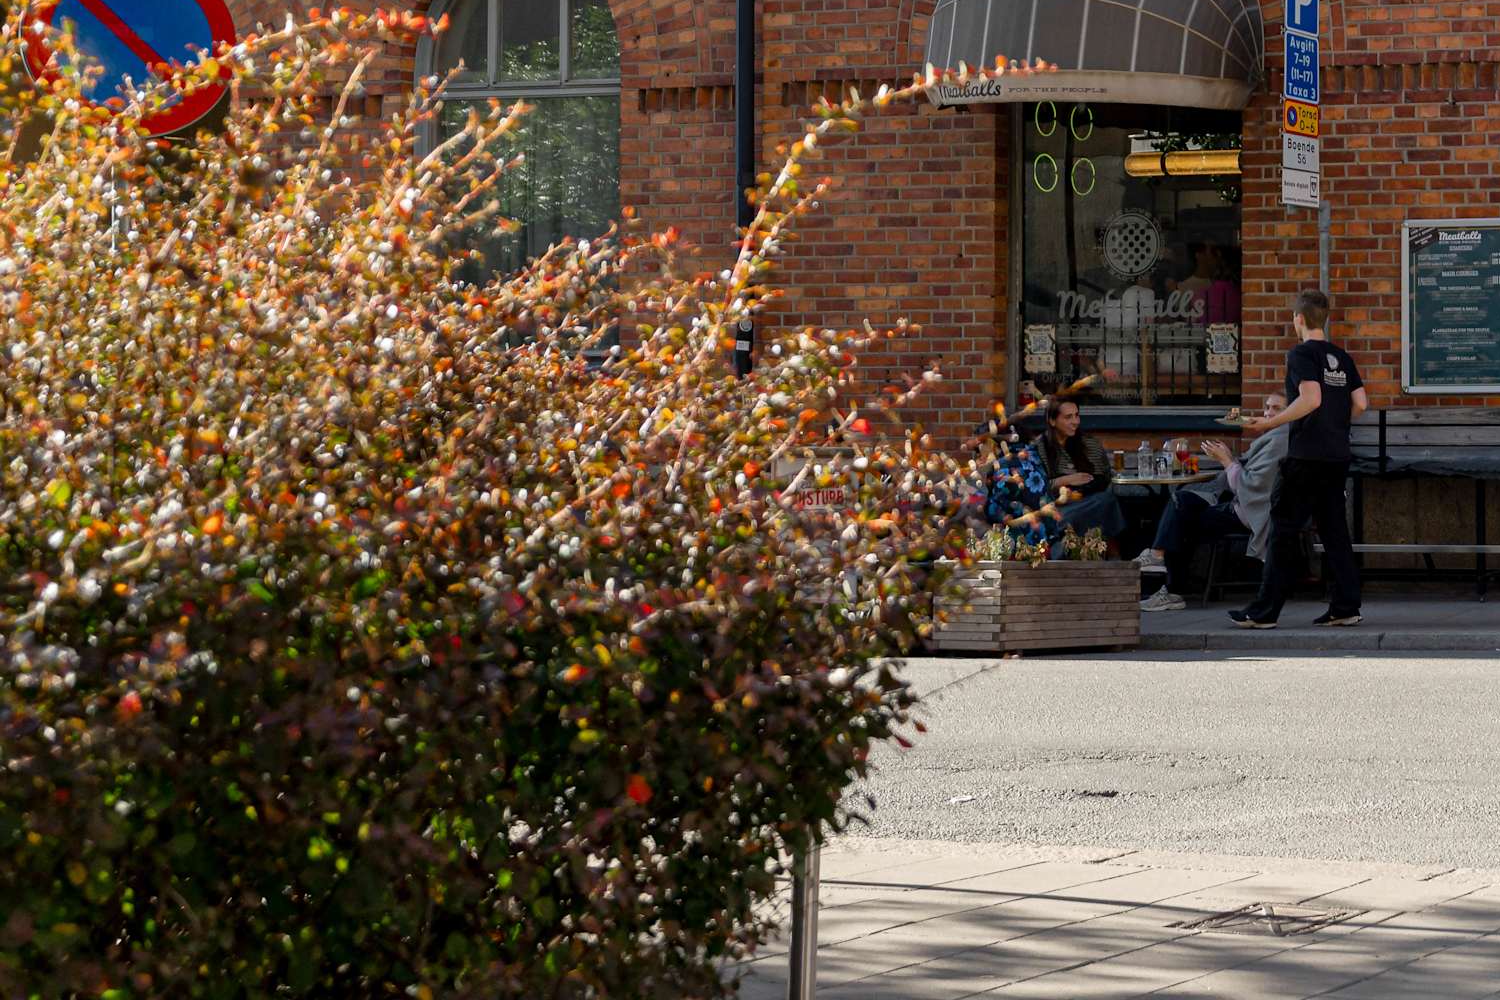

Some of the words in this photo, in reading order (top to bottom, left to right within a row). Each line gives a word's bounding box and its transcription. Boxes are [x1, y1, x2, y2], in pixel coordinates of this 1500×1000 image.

[1290, 35, 1315, 53] Avgift
[1288, 82, 1308, 97] Taxa
[1311, 87, 1316, 99] 3
[1287, 138, 1315, 153] Boende
[1056, 289, 1205, 319] Mealls
